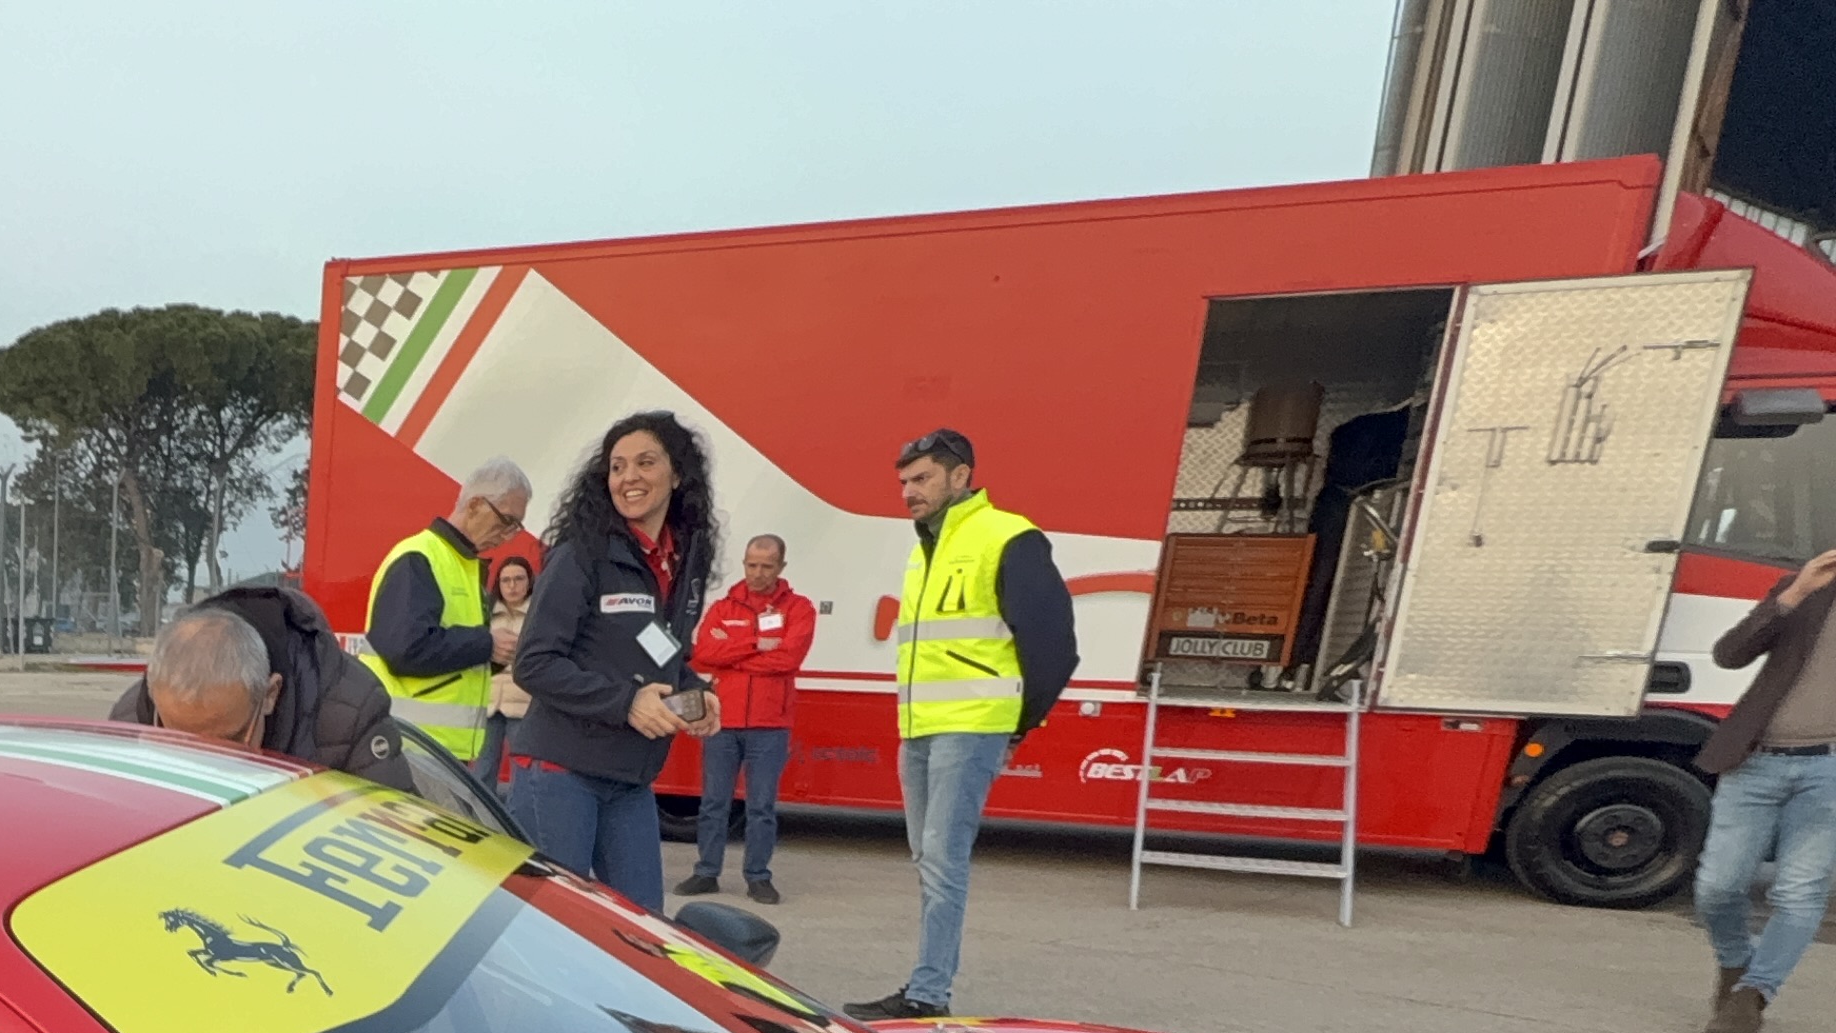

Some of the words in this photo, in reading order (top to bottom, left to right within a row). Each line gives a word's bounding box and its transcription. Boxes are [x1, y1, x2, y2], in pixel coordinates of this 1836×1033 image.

[1233, 611, 1279, 625] Beta
[1174, 639, 1219, 654] JOLLY
[1221, 641, 1265, 656] CLUB
[222, 785, 491, 933] Ferrar
